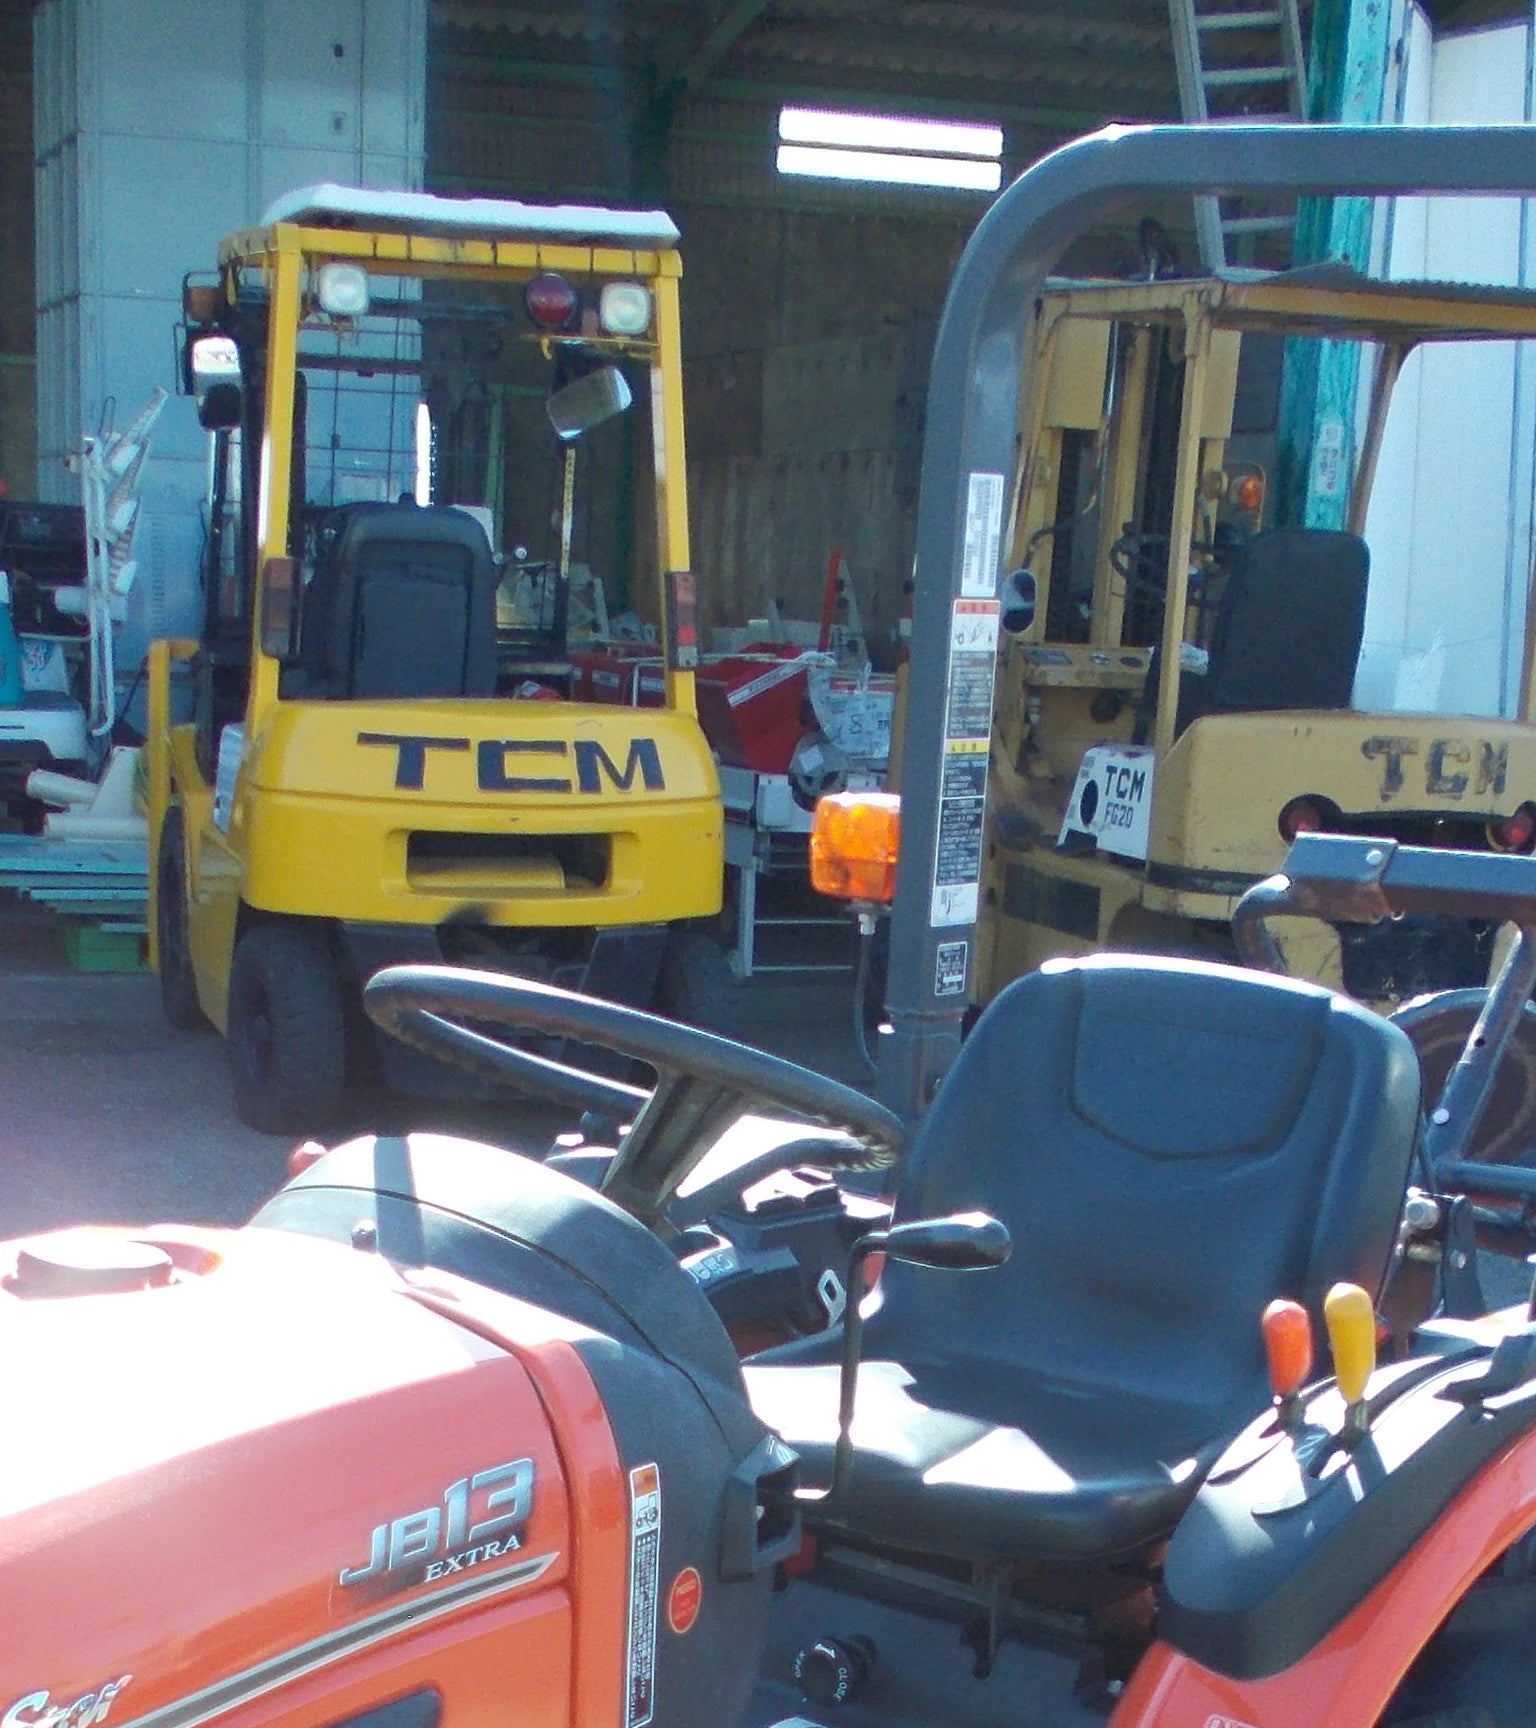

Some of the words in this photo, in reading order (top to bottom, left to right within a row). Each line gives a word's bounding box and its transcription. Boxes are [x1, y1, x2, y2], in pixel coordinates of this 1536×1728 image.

[356, 731, 667, 794] TCM
[1105, 764, 1146, 803] TCM
[1361, 735, 1509, 801] TCM
[1105, 804, 1134, 829] FG20
[339, 1458, 533, 1585] JB13
[424, 1535, 521, 1583] EXTRA
